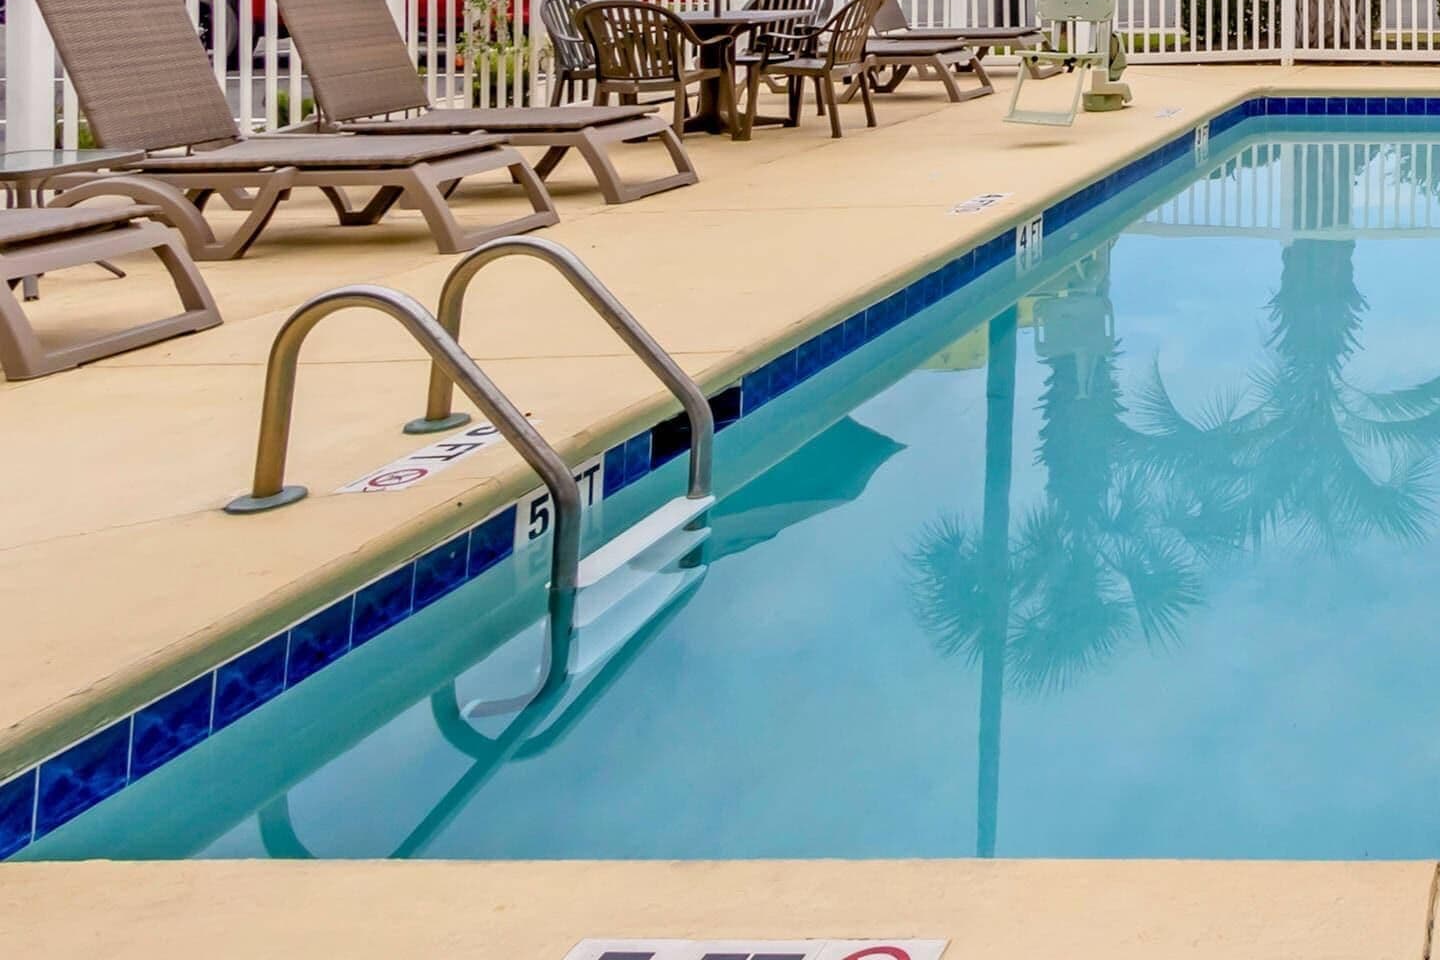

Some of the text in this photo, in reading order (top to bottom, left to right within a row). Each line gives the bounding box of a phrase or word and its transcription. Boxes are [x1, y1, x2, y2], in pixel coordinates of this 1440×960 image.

[1020, 216, 1042, 249] 4 FT
[528, 463, 600, 540] 5 T
